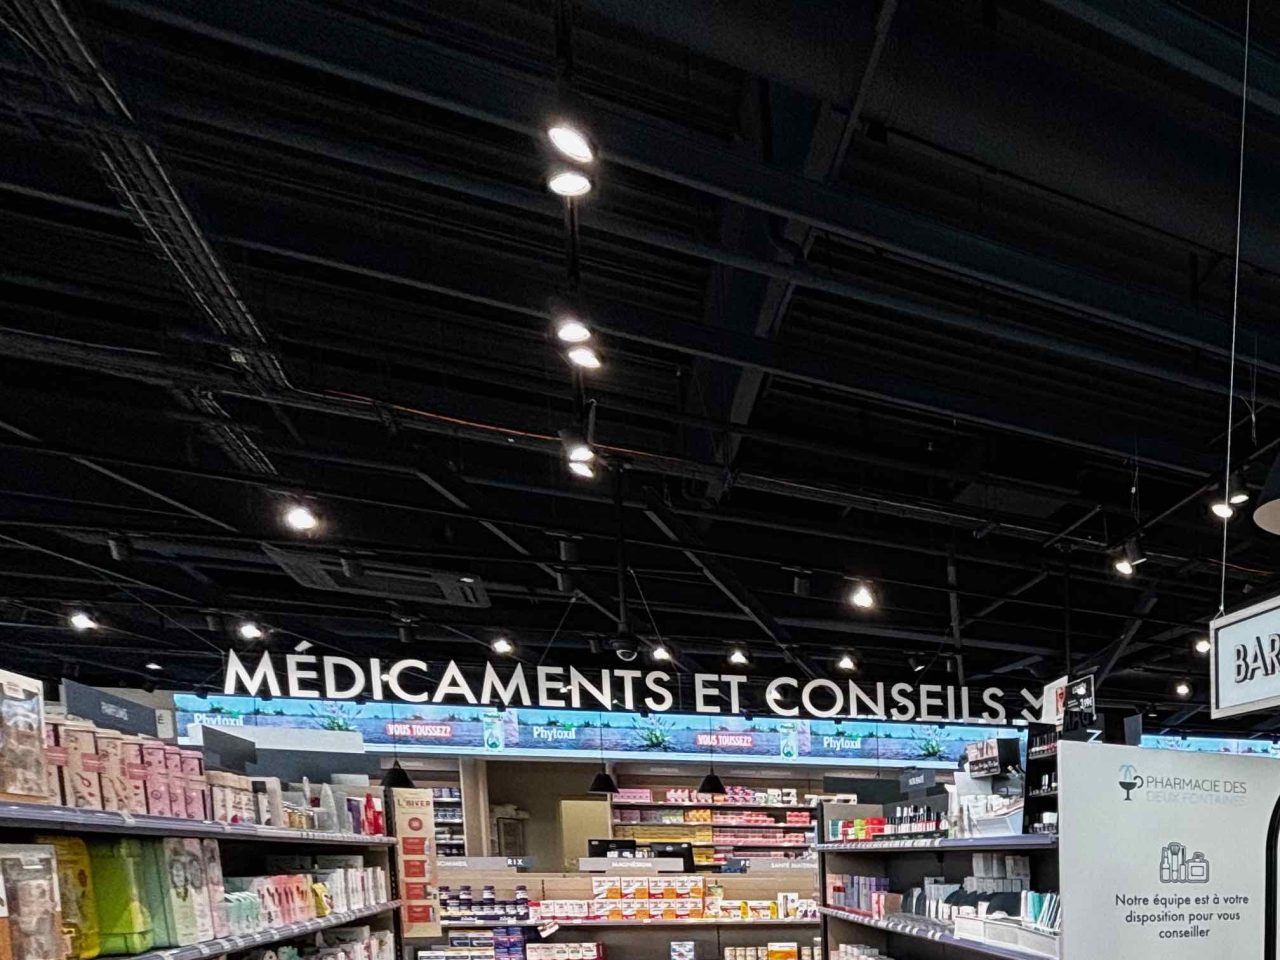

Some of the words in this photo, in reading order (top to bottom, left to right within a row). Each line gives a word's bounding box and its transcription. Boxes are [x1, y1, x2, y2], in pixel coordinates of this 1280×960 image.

[223, 640, 674, 711] MÉDICAMENTS
[695, 673, 747, 714] ET
[765, 677, 1008, 726] CONSEILS
[387, 724, 410, 736] VOUS
[412, 725, 452, 737] TOUSSEZ?
[533, 726, 576, 741] Phytoxil
[697, 734, 717, 746] VOUS
[719, 734, 752, 747] TOUSSEZ?
[823, 736, 861, 751] Phytoxil
[1146, 776, 1220, 792] PHARMACIE
[1223, 781, 1247, 793] DES
[1115, 894, 1149, 906] Notre
[1153, 894, 1191, 908] équipe
[1194, 895, 1210, 905] est
[1212, 893, 1220, 904] à
[1223, 895, 1249, 905] votre
[1125, 909, 1185, 925] disposition
[1188, 911, 1214, 924] pour
[1216, 911, 1240, 921] vous
[1158, 926, 1211, 939] conseiller
